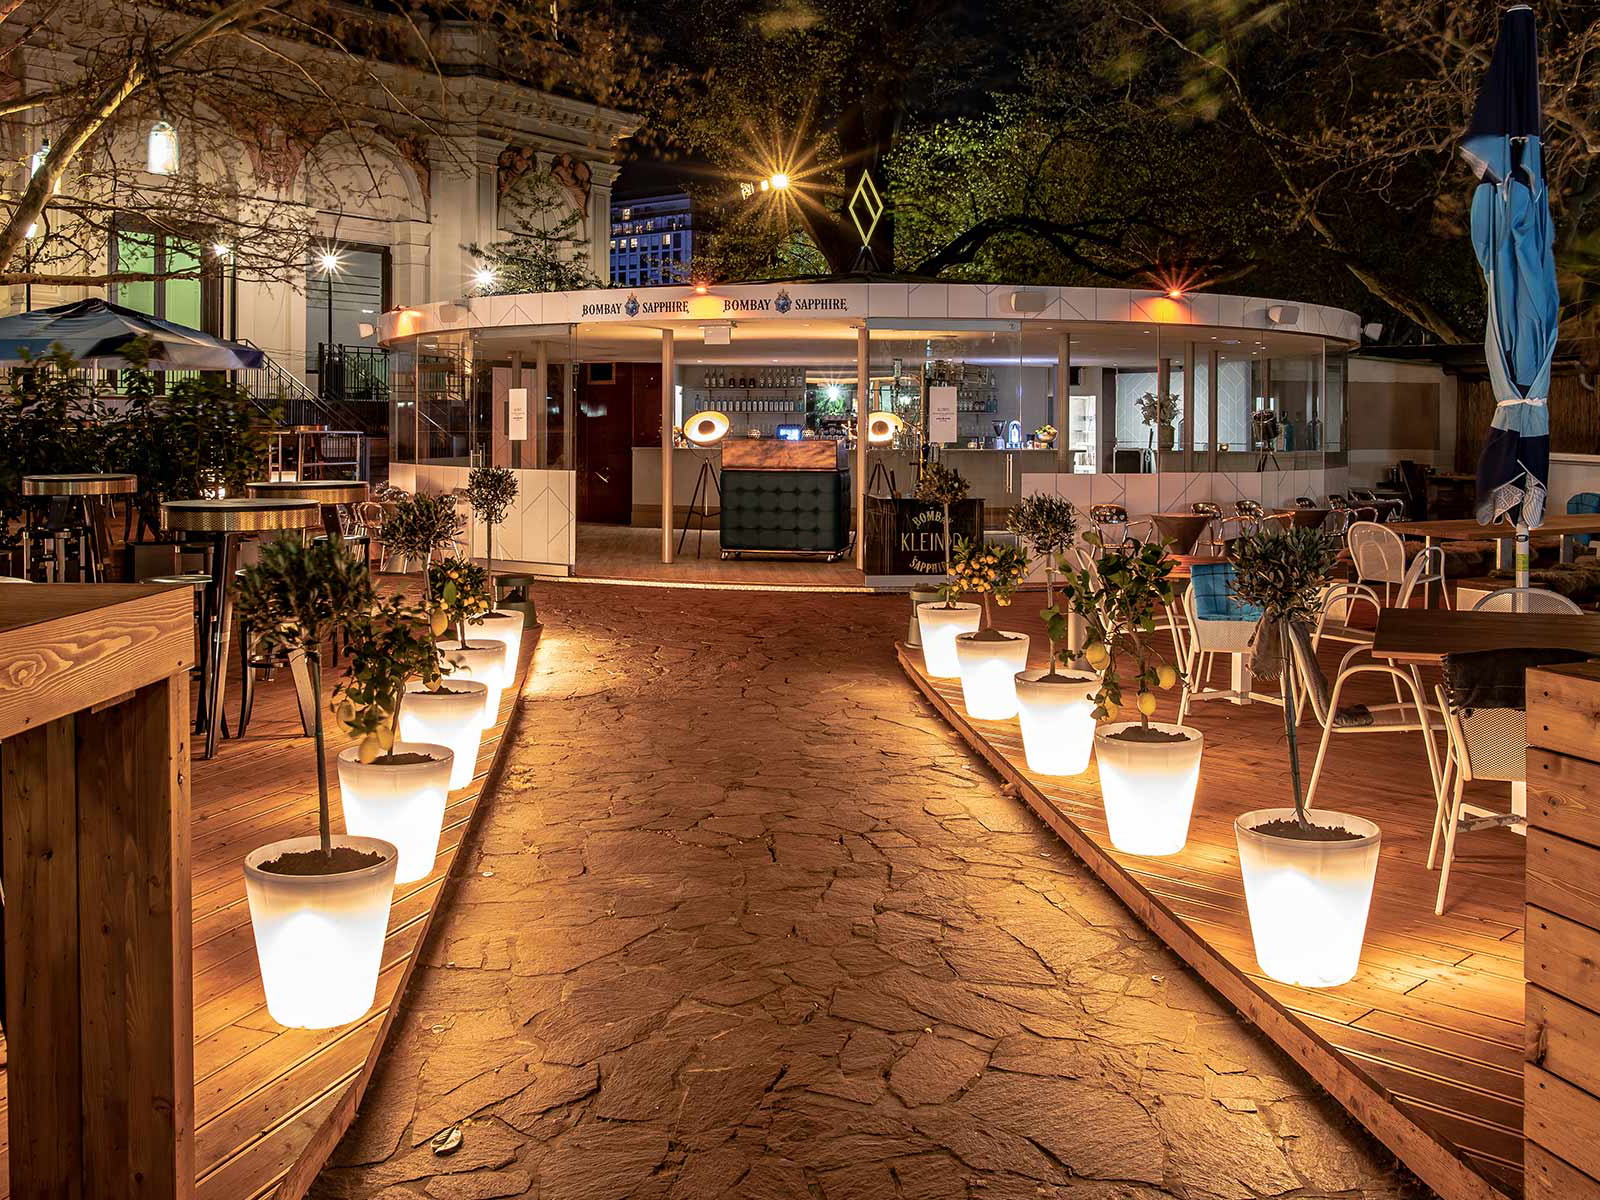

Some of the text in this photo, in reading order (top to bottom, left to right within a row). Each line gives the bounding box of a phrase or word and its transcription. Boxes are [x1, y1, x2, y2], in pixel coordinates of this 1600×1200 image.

[582, 301, 690, 317] BOMBAY SAPPHIRE
[723, 299, 848, 312] BOMBAY SAPPHIRE
[912, 510, 954, 529] BOMBA
